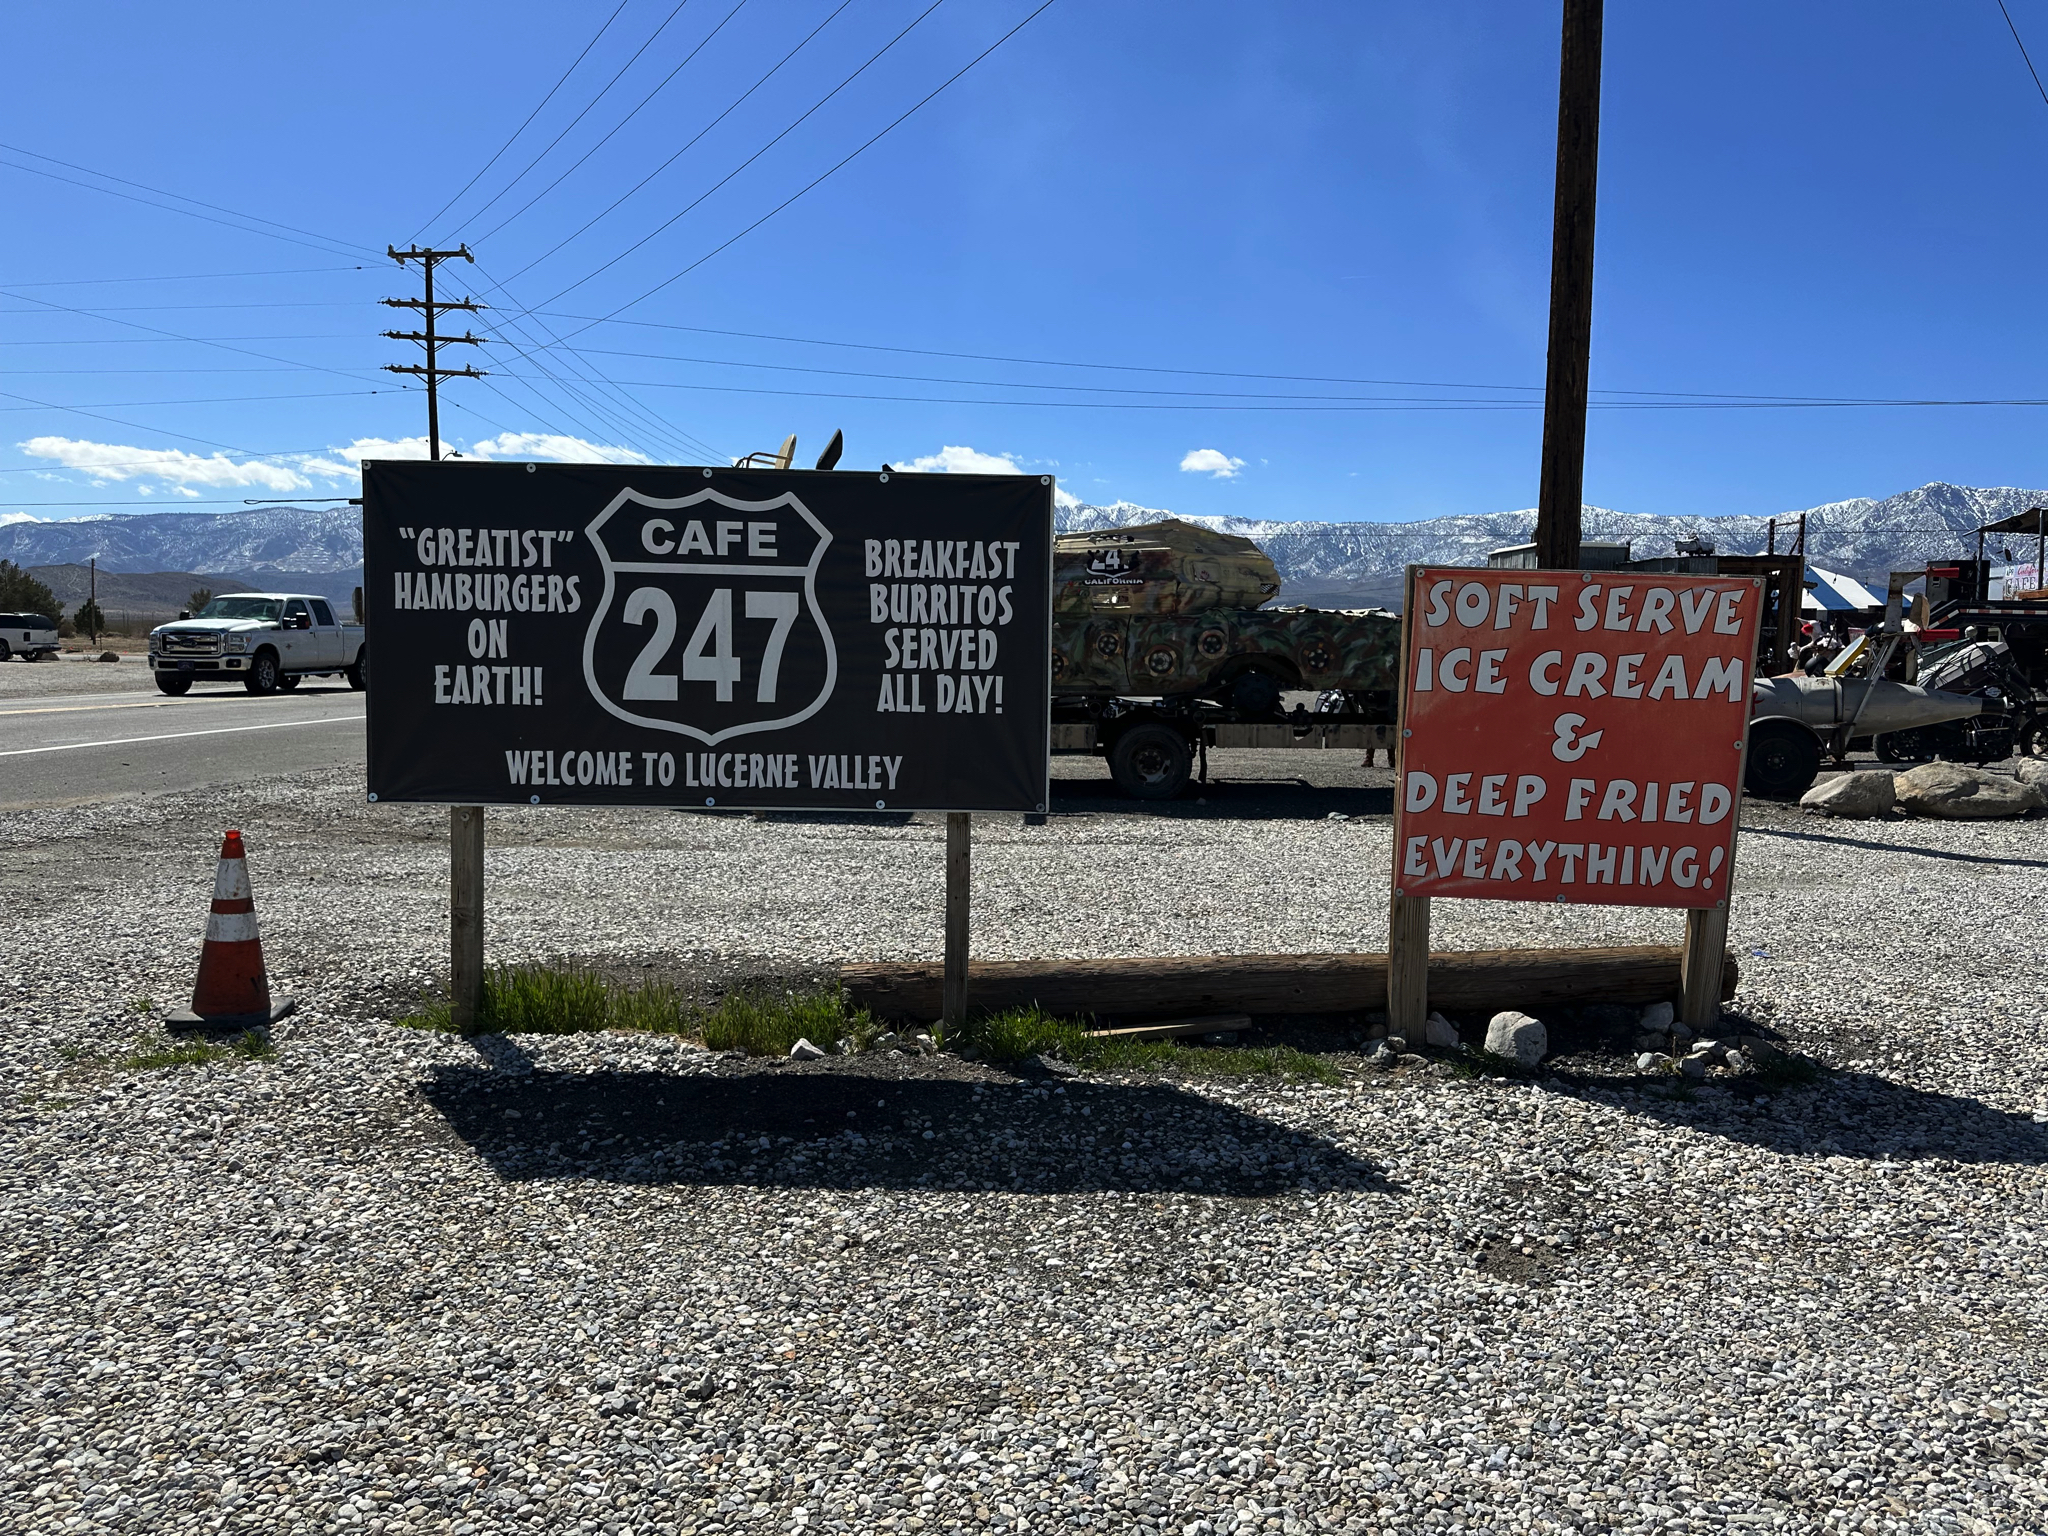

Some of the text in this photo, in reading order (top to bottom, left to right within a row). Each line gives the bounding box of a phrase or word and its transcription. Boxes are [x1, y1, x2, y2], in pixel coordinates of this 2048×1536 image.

[399, 527, 574, 568] "GREATIST"
[641, 518, 778, 557] CAFE
[864, 538, 1020, 580] BREAKFAST
[394, 572, 581, 614] HAMBURGERS
[869, 583, 1013, 626] BURRITOS
[1425, 580, 1746, 635] SOFT SERVE
[467, 618, 508, 659] ON
[622, 586, 799, 703] 247
[884, 627, 998, 671] SERVED
[434, 664, 543, 706] EARTH!
[876, 673, 1004, 714] ALL DAY!
[1414, 647, 1744, 703] ICE CREAM
[1552, 713, 1603, 762] &
[505, 750, 903, 790] WELCOME TO LUCERNE VALLEY
[1405, 771, 1732, 825] DEEP FRIED
[1403, 835, 1724, 889] EVERYTHING!
